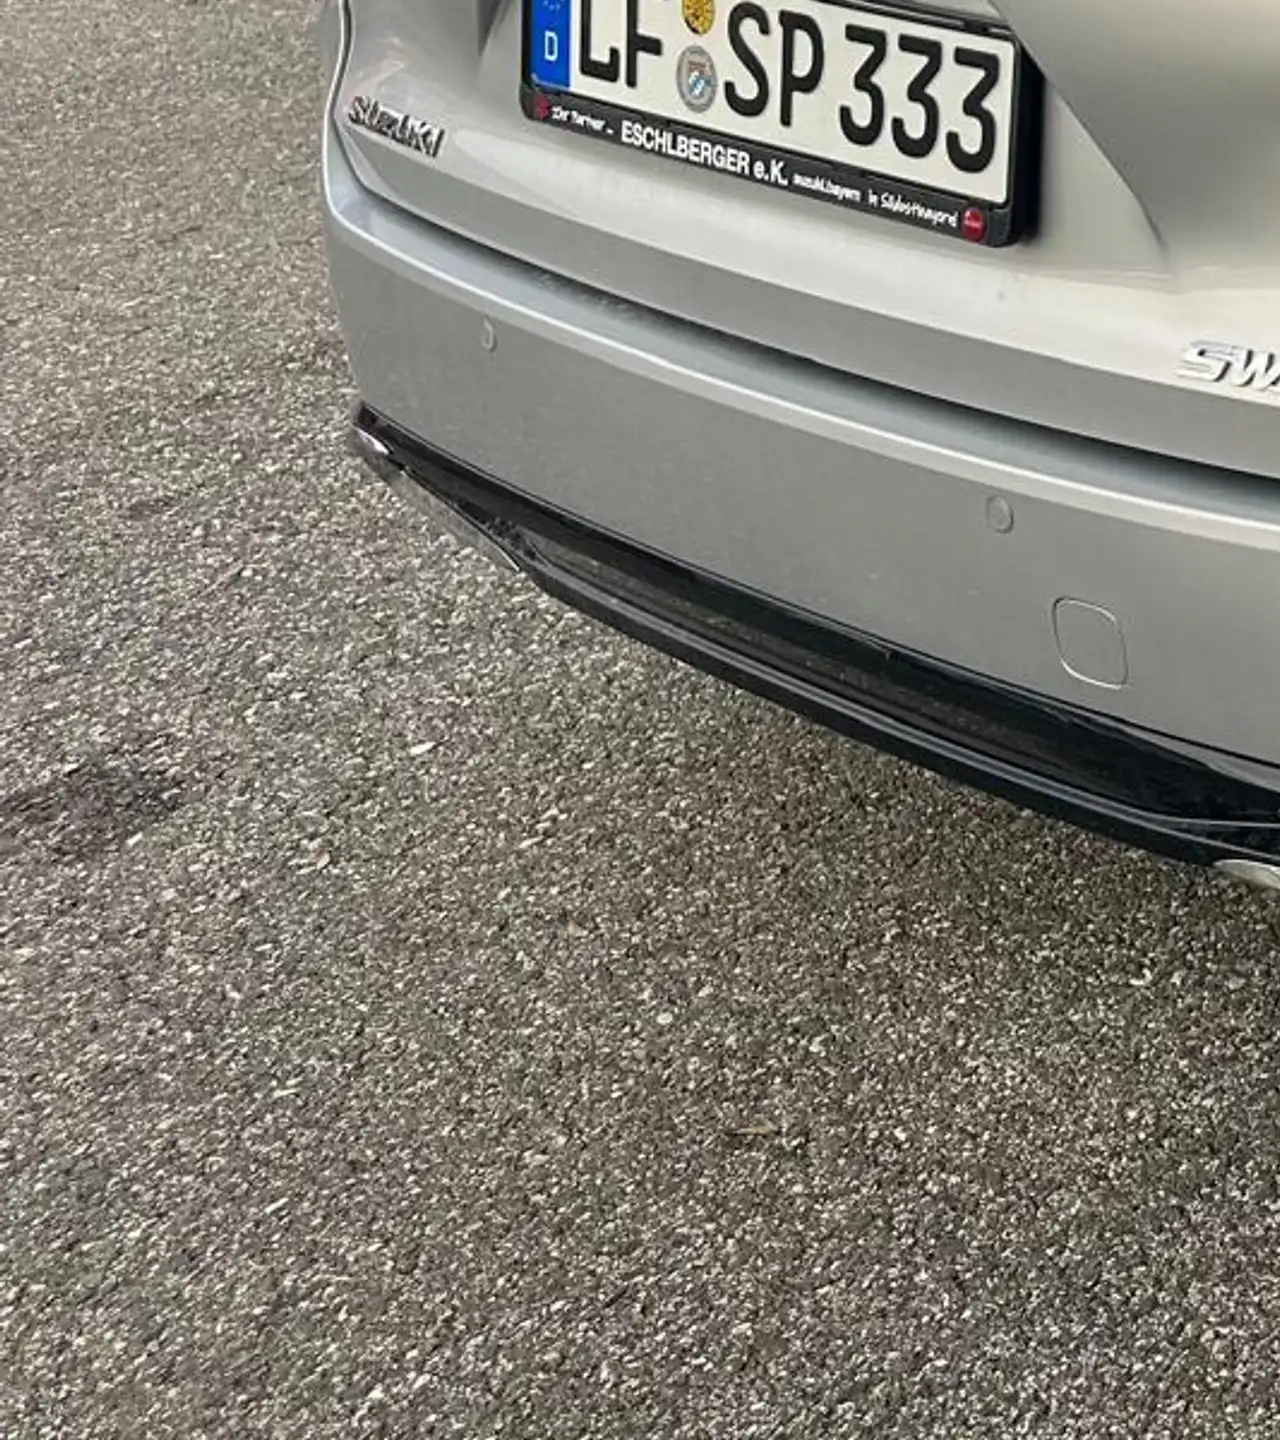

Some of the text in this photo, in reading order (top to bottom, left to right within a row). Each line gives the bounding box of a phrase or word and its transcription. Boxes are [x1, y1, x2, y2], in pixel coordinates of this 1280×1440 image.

[543, 31, 559, 62] D
[347, 95, 446, 159] SUZUKI
[620, 119, 750, 175] ESCHLBERGER
[752, 159, 789, 186] e.K.
